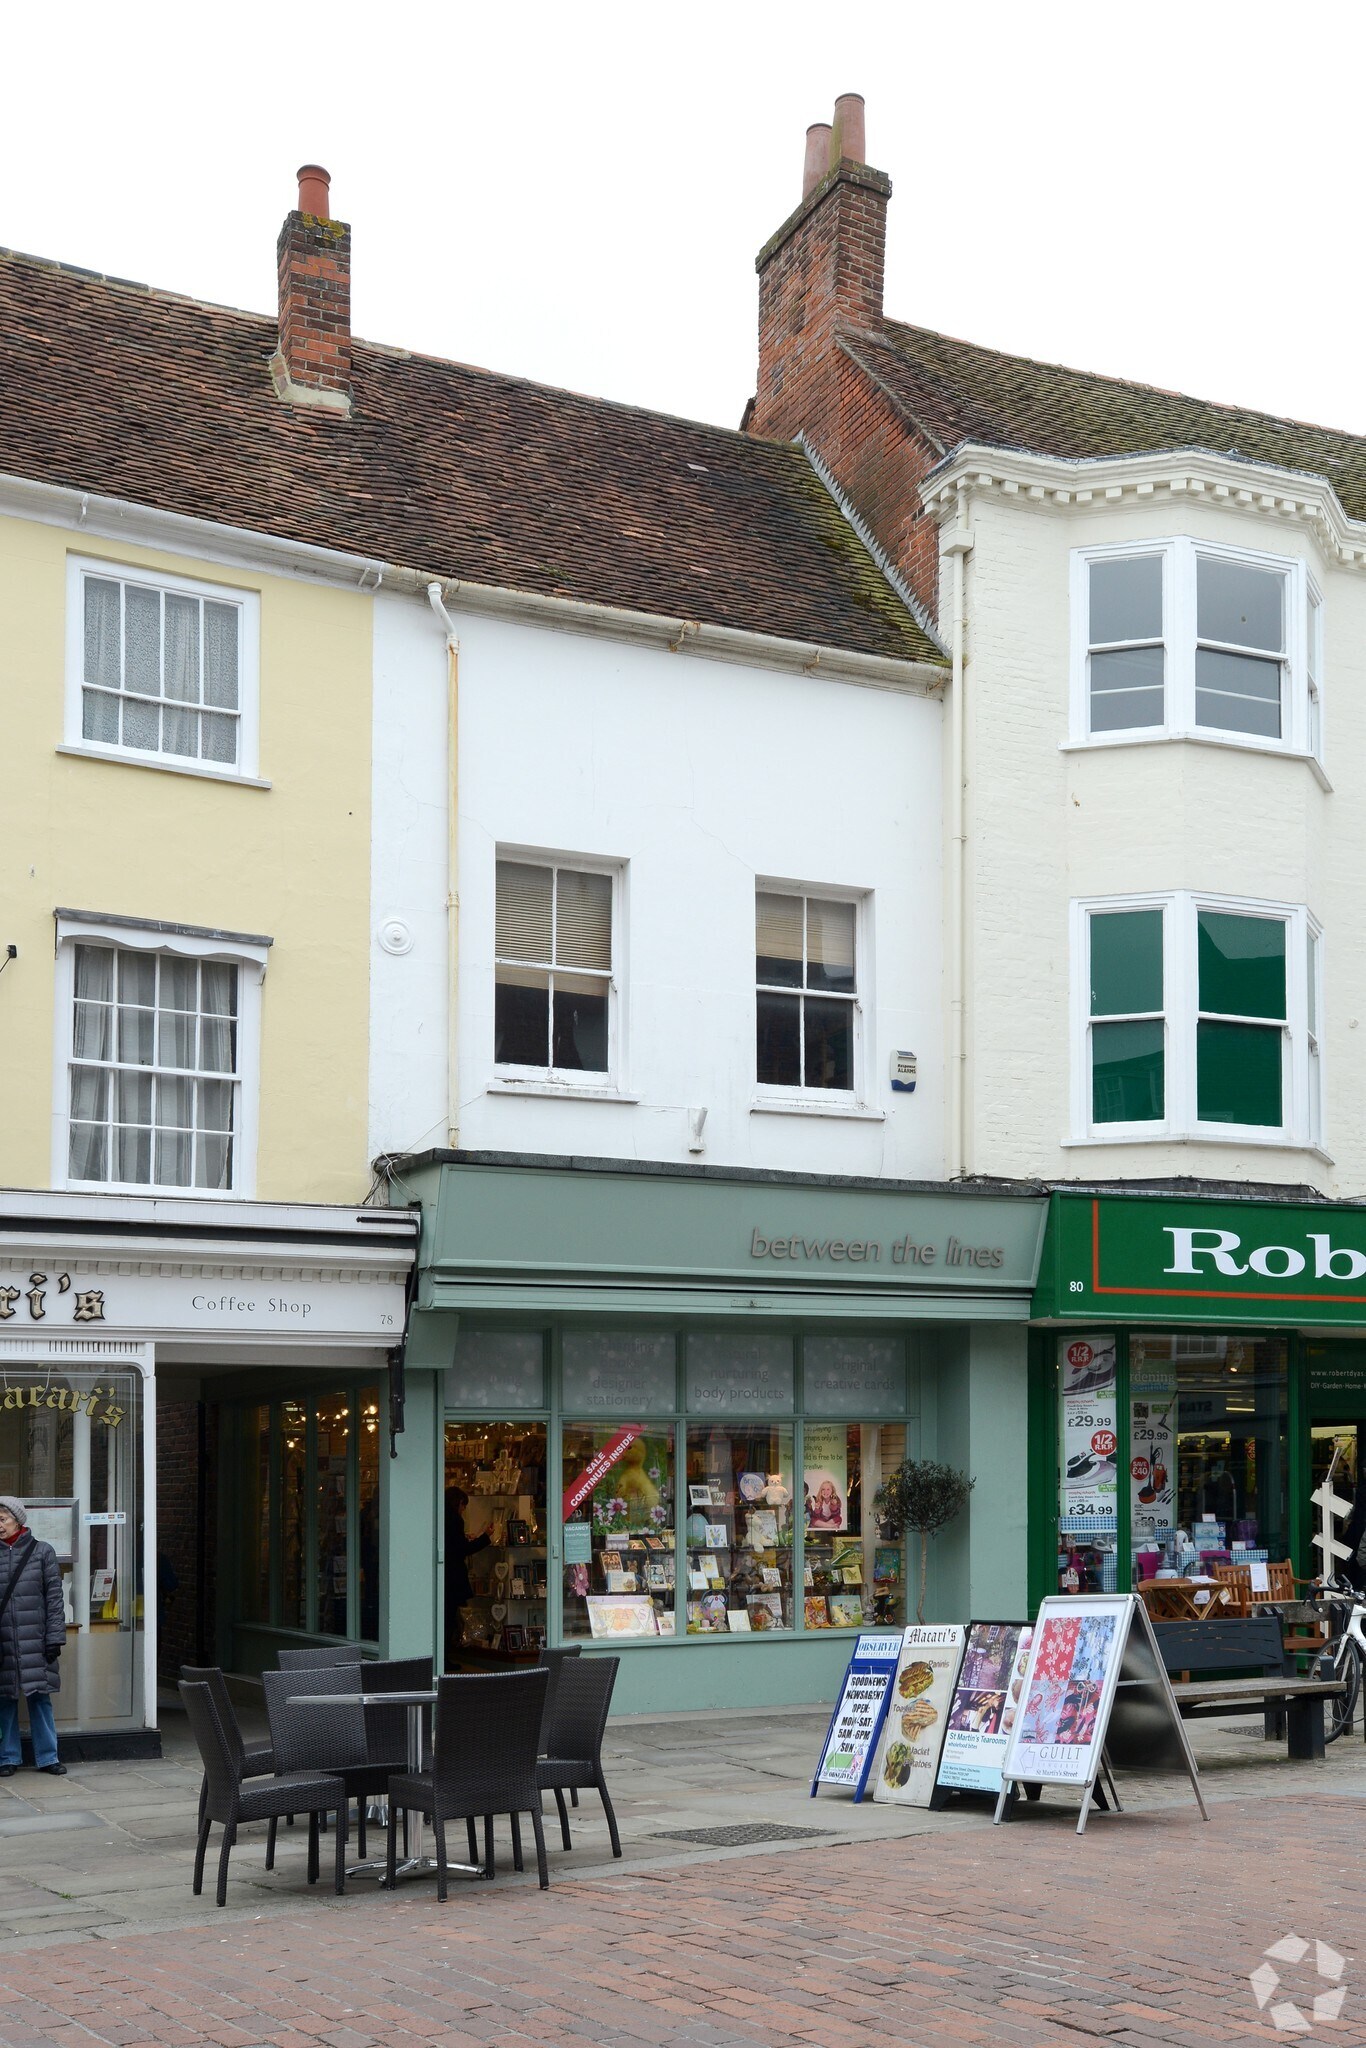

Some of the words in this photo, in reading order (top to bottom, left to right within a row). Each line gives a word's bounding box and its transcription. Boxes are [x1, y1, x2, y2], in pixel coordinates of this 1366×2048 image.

[751, 1226, 881, 1262] between
[892, 1234, 937, 1265] the
[945, 1236, 1006, 1268] lines
[1163, 1227, 1366, 1280] Rob
[1069, 1281, 1084, 1293] 80
[192, 1296, 256, 1312] Coffee
[268, 1298, 312, 1318] Shop
[380, 1314, 394, 1325] 78
[1071, 1346, 1088, 1356] 1/2
[833, 1358, 877, 1373] original
[711, 1368, 769, 1383] nurturing
[593, 1375, 647, 1393] designer
[814, 1378, 860, 1390] creative
[865, 1378, 896, 1391] cards
[695, 1386, 725, 1402] body
[730, 1387, 785, 1401] products
[0, 1384, 127, 1429] acari's
[587, 1394, 654, 1408] stationery
[1067, 1415, 1111, 1428] £29.99
[1093, 1434, 1112, 1445] 1/2
[1133, 1429, 1167, 1440] £29.99
[586, 1451, 606, 1475] SALE
[818, 1453, 829, 1461] free
[570, 1460, 611, 1507] CONTINUES
[610, 1433, 635, 1462] INSIDE
[1132, 1466, 1148, 1475] £40
[1068, 1503, 1112, 1516] £34.99
[908, 1628, 958, 1645] Macari's
[859, 1642, 899, 1651] OBSERVER
[928, 1660, 950, 1669] Paninis
[851, 1676, 888, 1687] GOODNEWS
[845, 1690, 885, 1700] NEWSAGENT
[852, 1703, 870, 1714] OPEN:
[949, 1732, 956, 1740] St
[957, 1733, 980, 1743] Martin's
[981, 1735, 1008, 1746] Tearooms
[911, 1746, 931, 1756] Jacket
[1040, 1746, 1083, 1760] GUILT
[1042, 1769, 1062, 1777] Martin's
[1063, 1770, 1079, 1778] Street
